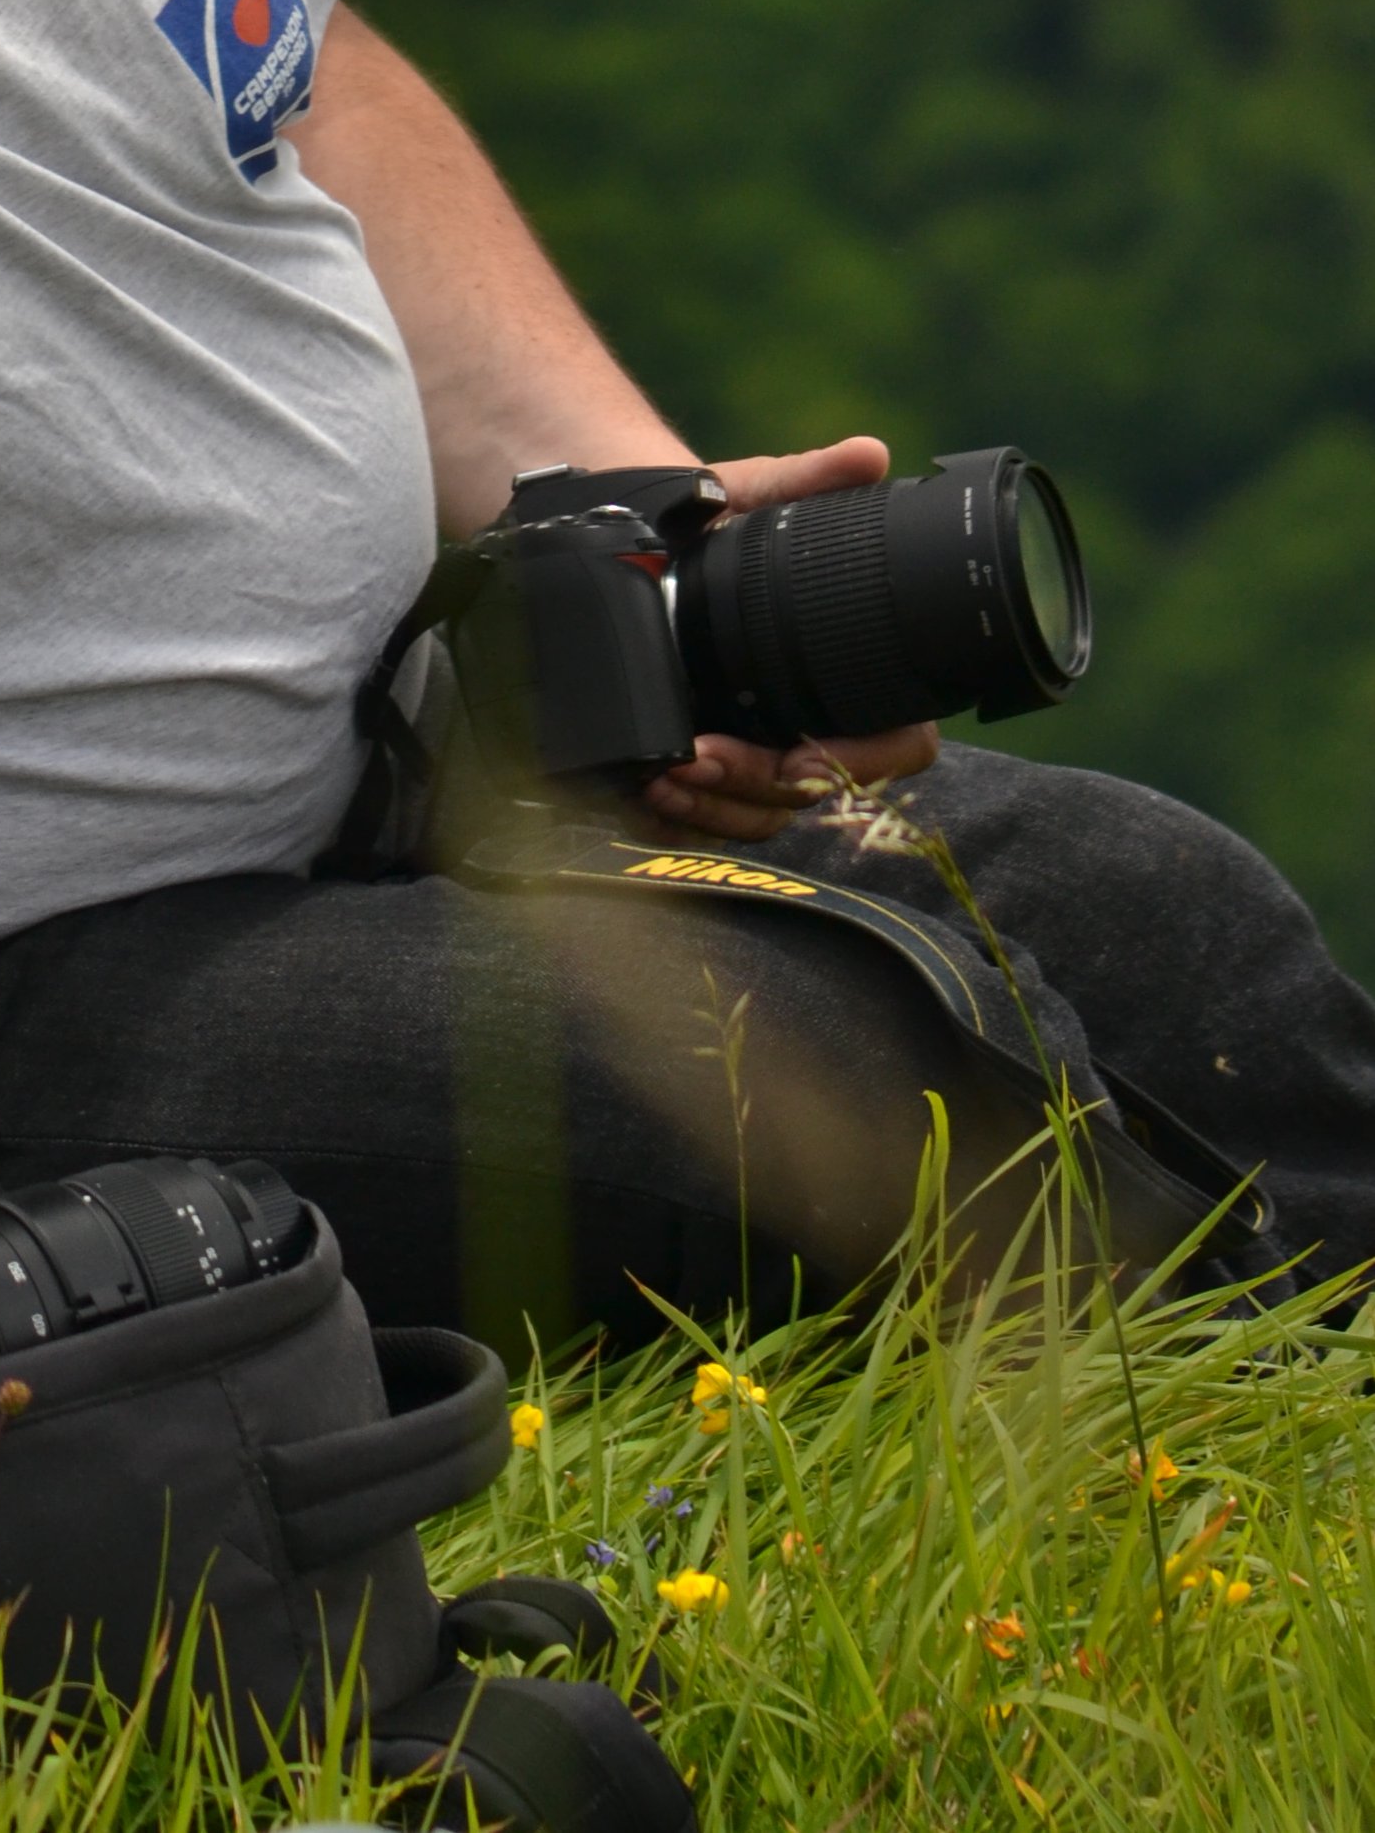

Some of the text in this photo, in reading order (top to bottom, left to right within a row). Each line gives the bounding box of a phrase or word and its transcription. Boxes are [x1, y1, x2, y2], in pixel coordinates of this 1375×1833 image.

[234, 5, 303, 114] CAMPENON
[251, 30, 307, 122] BERNARD
[624, 856, 818, 896] Nikon
